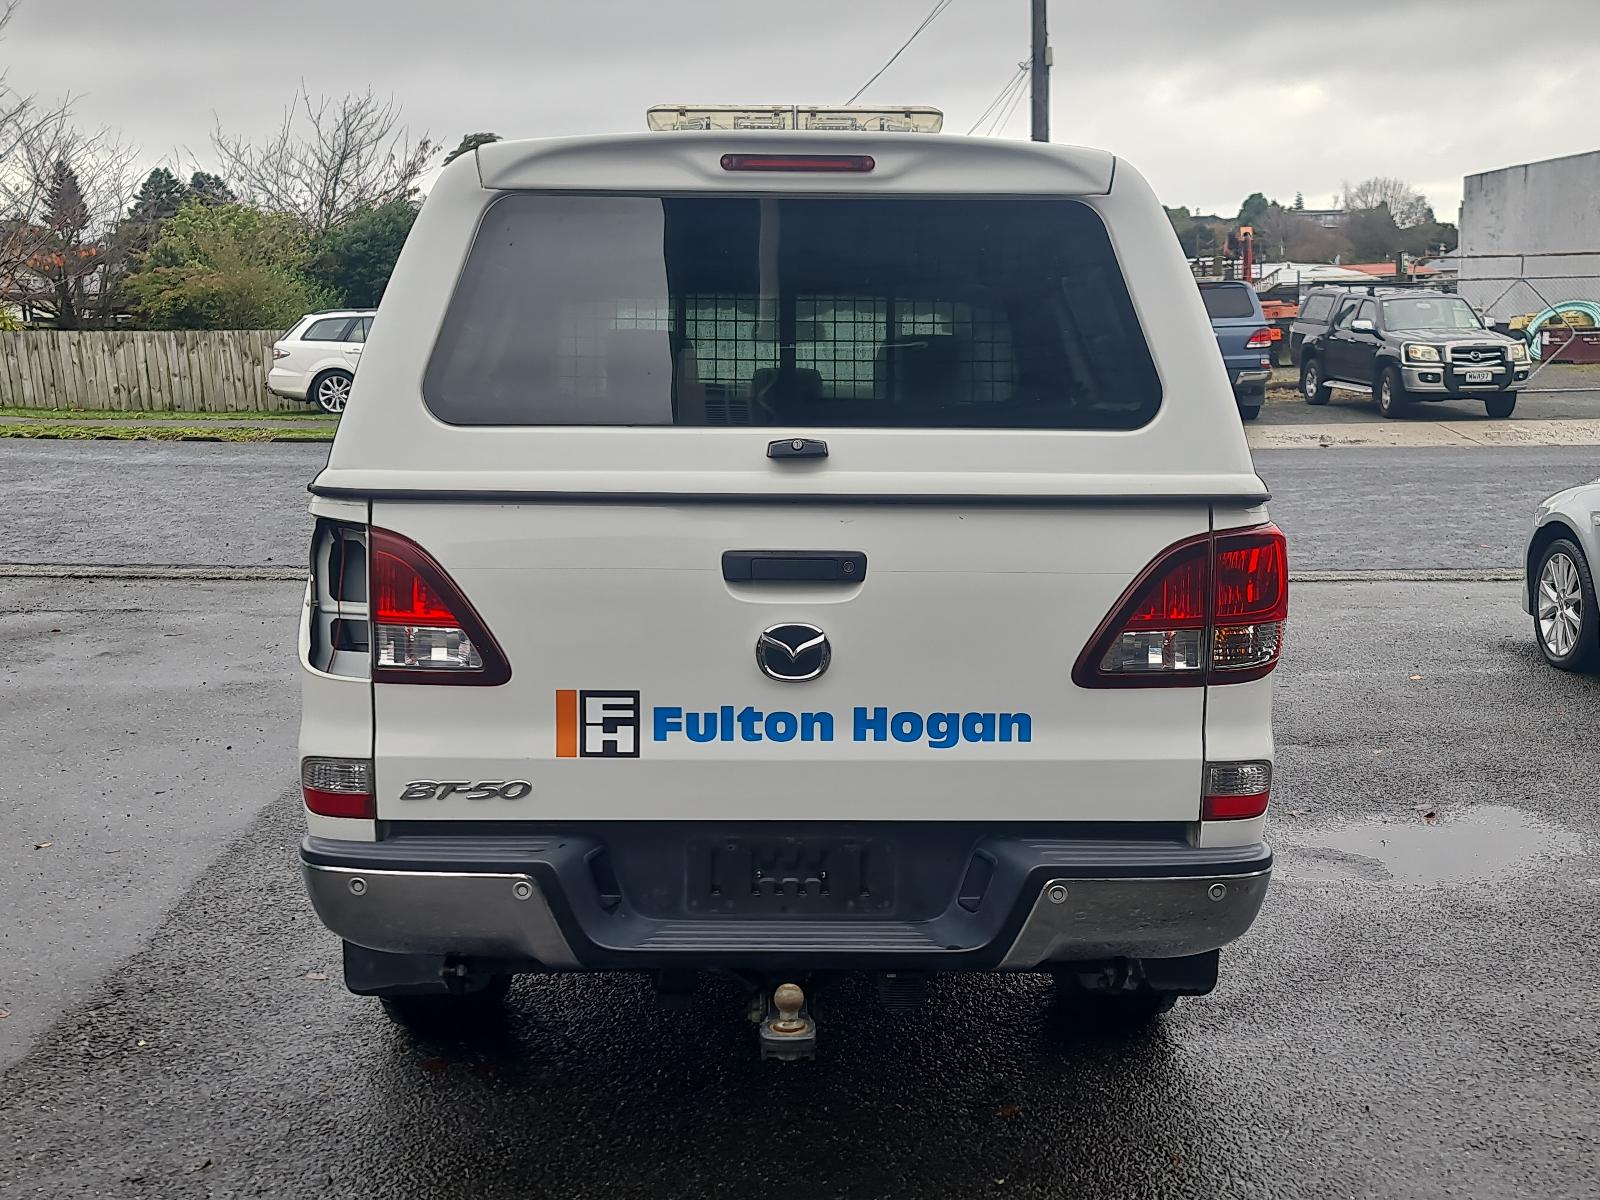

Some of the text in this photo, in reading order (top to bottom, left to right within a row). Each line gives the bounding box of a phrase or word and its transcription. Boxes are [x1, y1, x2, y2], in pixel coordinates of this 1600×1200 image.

[653, 706, 1032, 749] Fulton Hogan
[400, 779, 532, 800] BT-50
